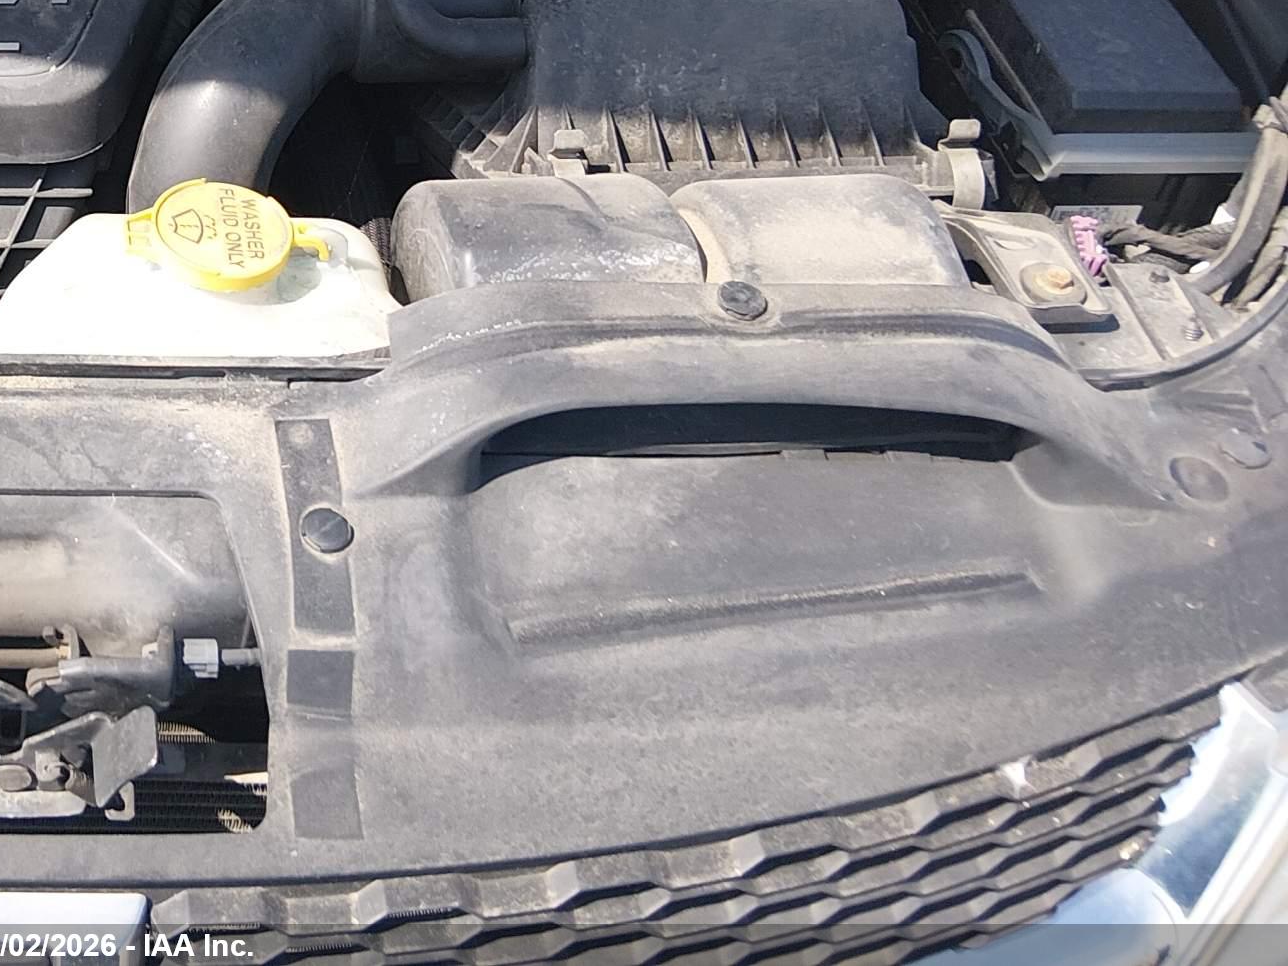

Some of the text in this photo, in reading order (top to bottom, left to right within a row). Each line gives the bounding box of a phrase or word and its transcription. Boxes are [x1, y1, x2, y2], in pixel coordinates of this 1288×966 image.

[218, 187, 245, 268] FLUID ONLY
[241, 199, 265, 260] WASHER
